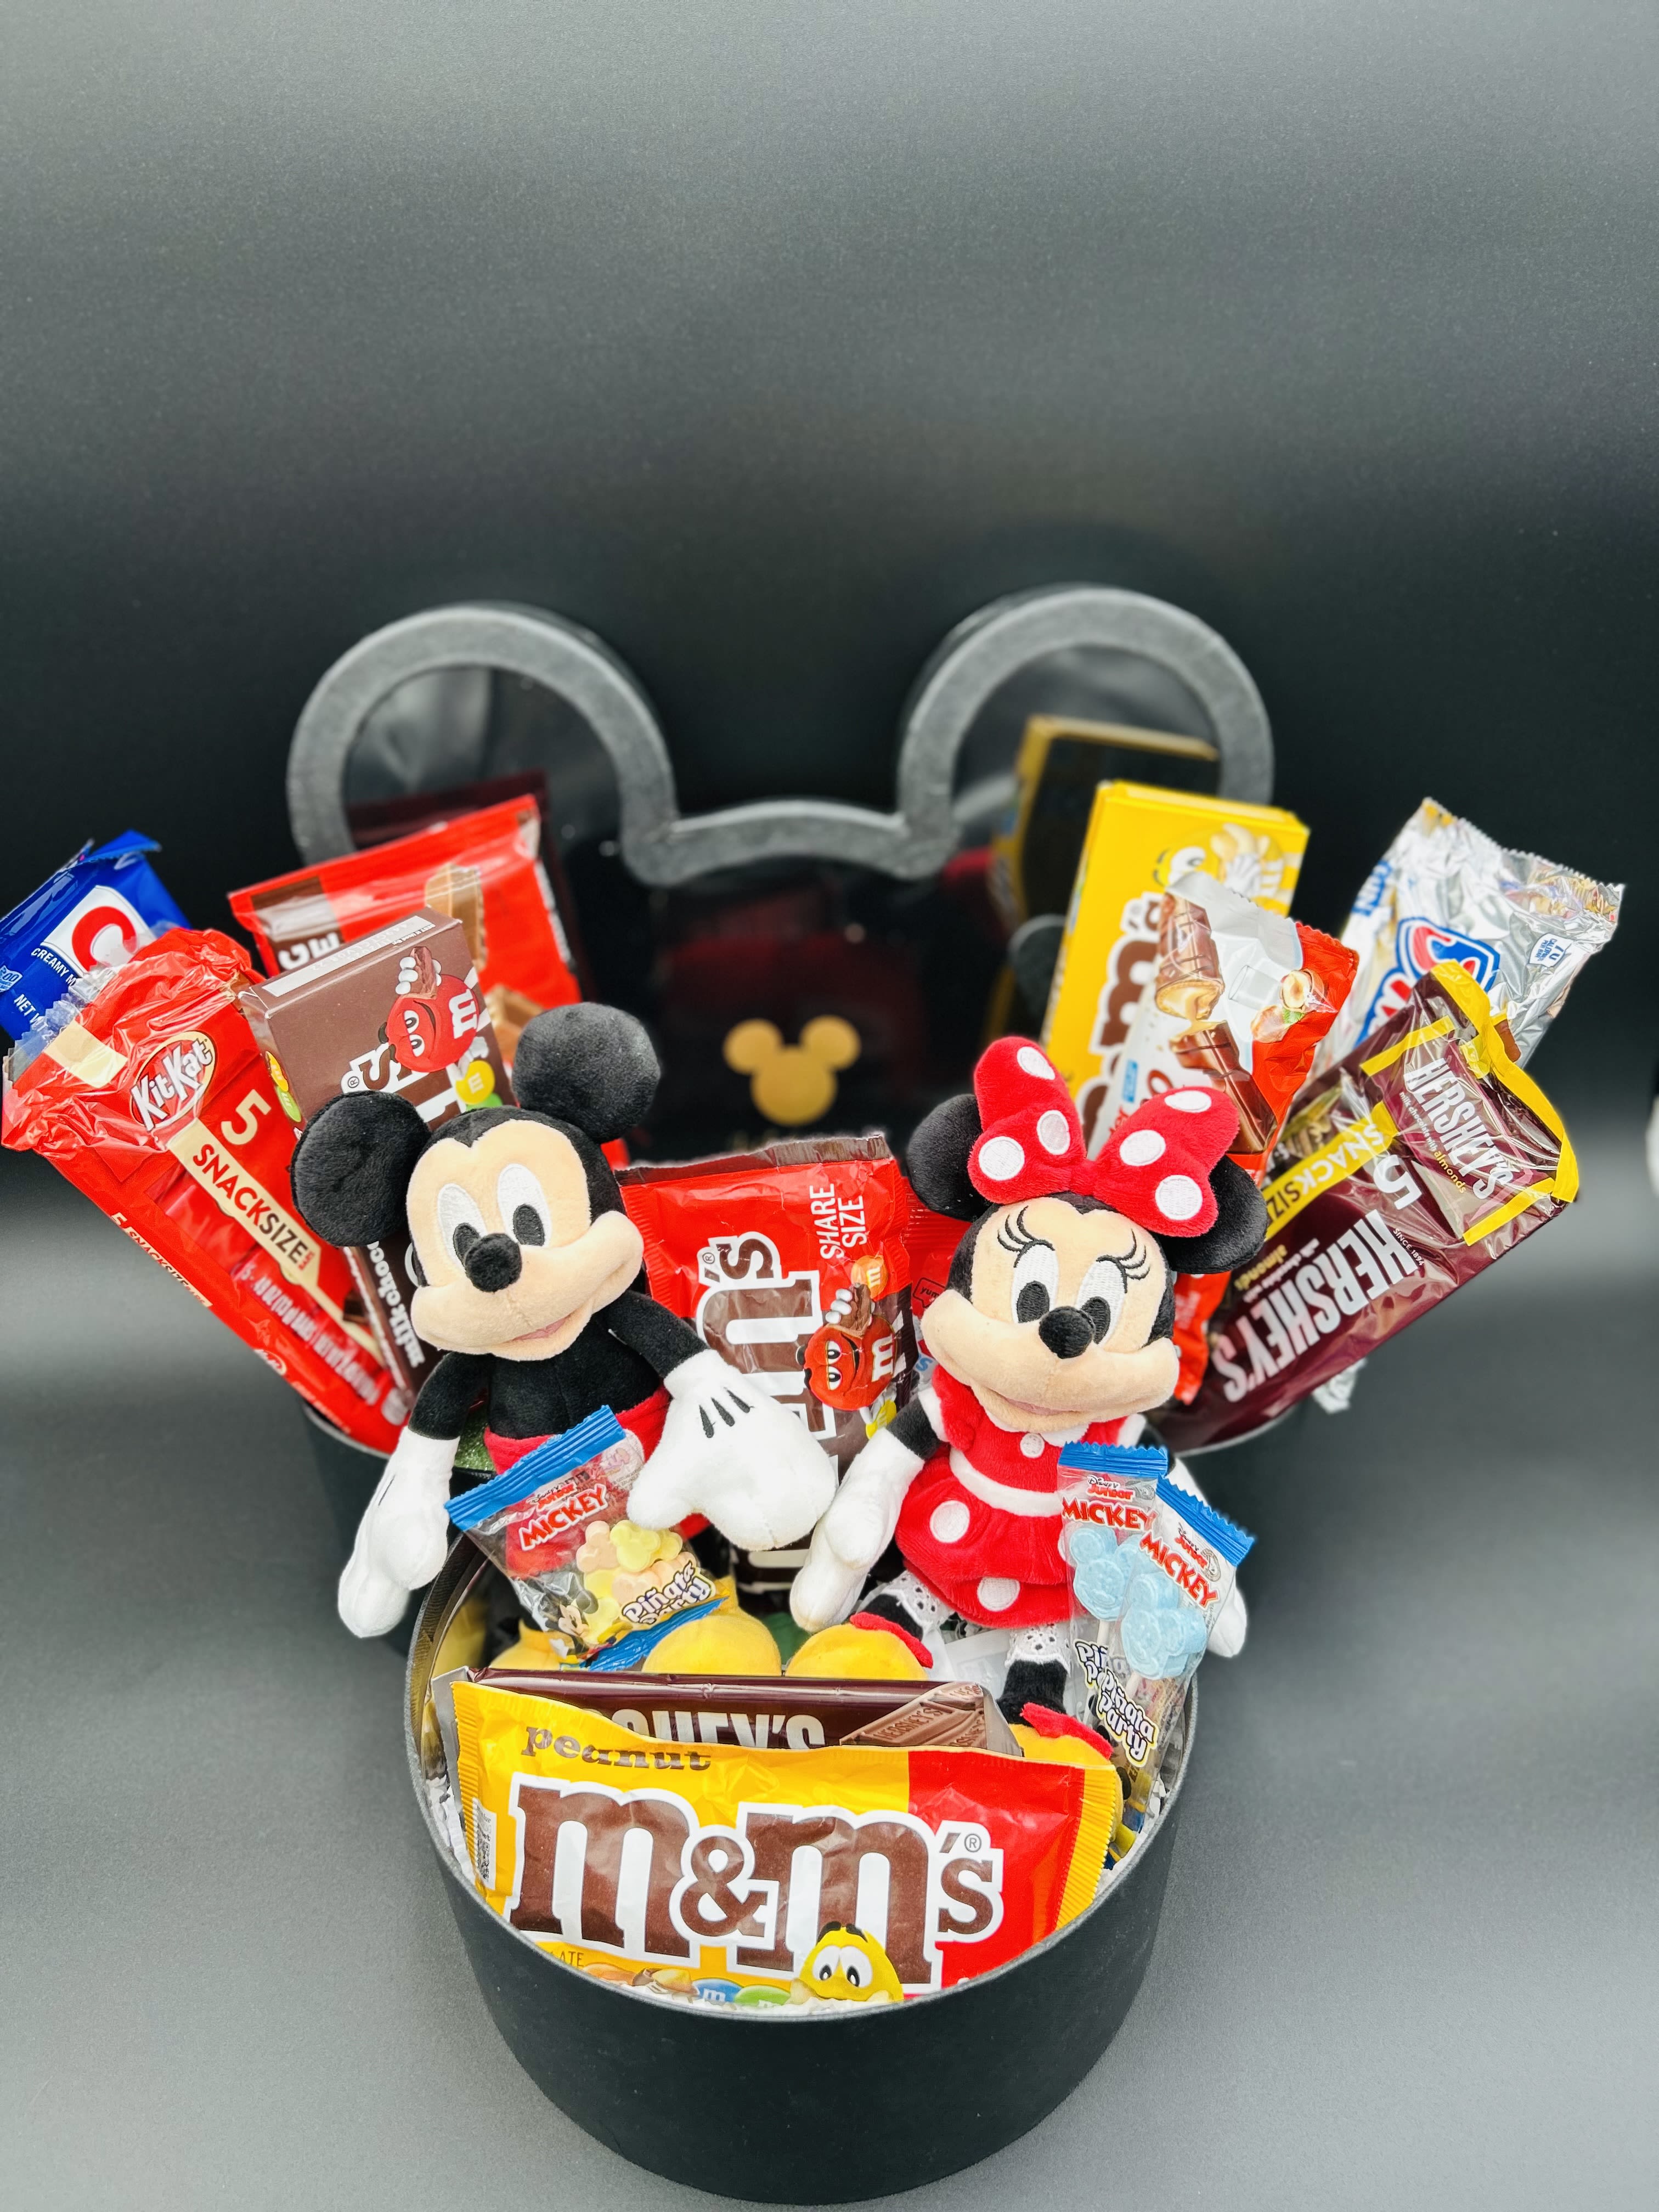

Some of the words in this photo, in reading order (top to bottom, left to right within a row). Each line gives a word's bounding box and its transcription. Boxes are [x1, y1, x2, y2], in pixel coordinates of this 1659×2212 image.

[31, 947, 70, 977] CREAMY
[14, 994, 37, 1017] NET
[221, 1089, 272, 1145] 5
[1400, 1092, 1411, 1108] milk
[1408, 1106, 1431, 1138] chocolate
[1434, 1151, 1467, 1194] almonds
[1404, 1057, 1514, 1200] HERSHEY'S
[1265, 1123, 1384, 1218] SNACKSIZ
[1373, 1154, 1423, 1210] 5
[193, 1144, 308, 1264] SNACKSIZE
[809, 1183, 845, 1260] SHARE
[837, 1195, 868, 1248] SIZE
[1393, 1228, 1412, 1251] SINCE
[1408, 1248, 1425, 1267] 1894
[1211, 1209, 1420, 1403] HERSHEY'S
[520, 1484, 607, 1550] MICKEY
[1062, 1496, 1159, 1530] MICKEY
[622, 1559, 696, 1623] Piñata
[1139, 1531, 1218, 1609] MICKEY
[1098, 1691, 1148, 1762] Party
[1101, 1667, 1155, 1744] Piñata
[521, 1726, 712, 1771] peanut
